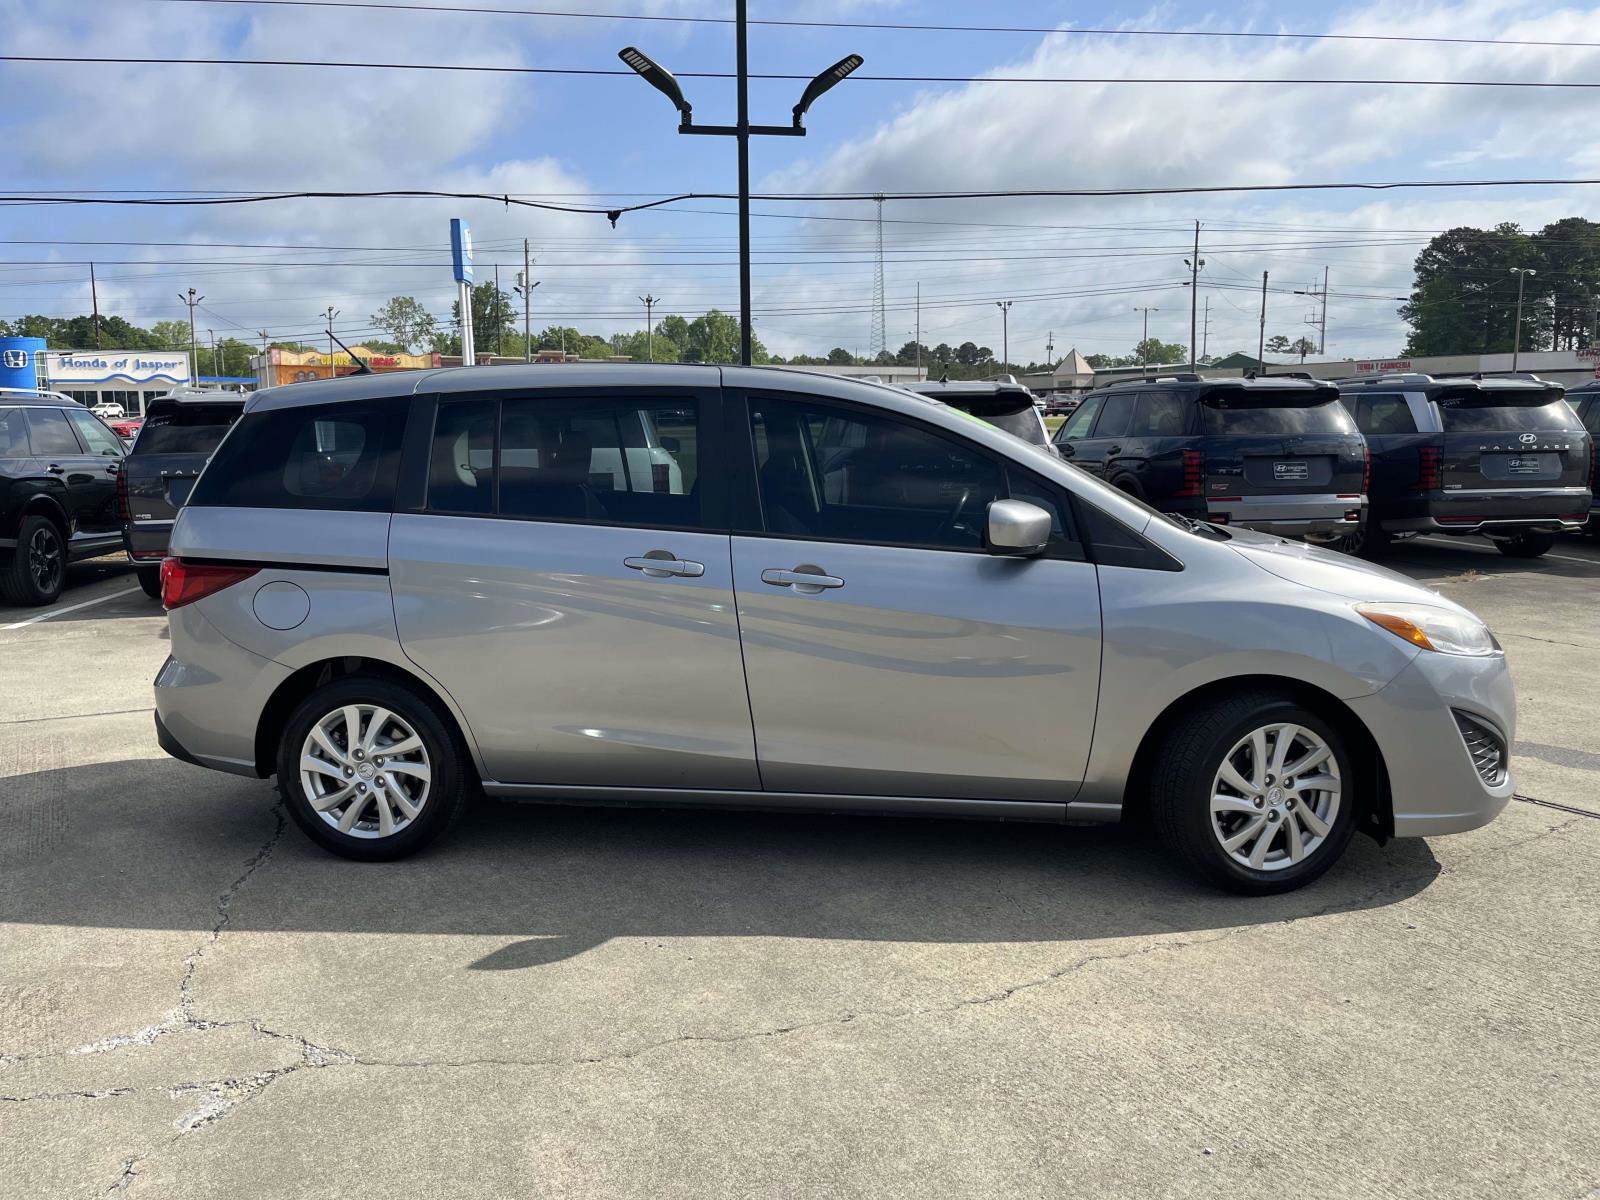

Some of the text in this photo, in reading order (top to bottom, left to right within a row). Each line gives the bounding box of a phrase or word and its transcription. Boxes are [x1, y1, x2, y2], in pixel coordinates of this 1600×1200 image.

[61, 357, 177, 370] Honda of Jasper
